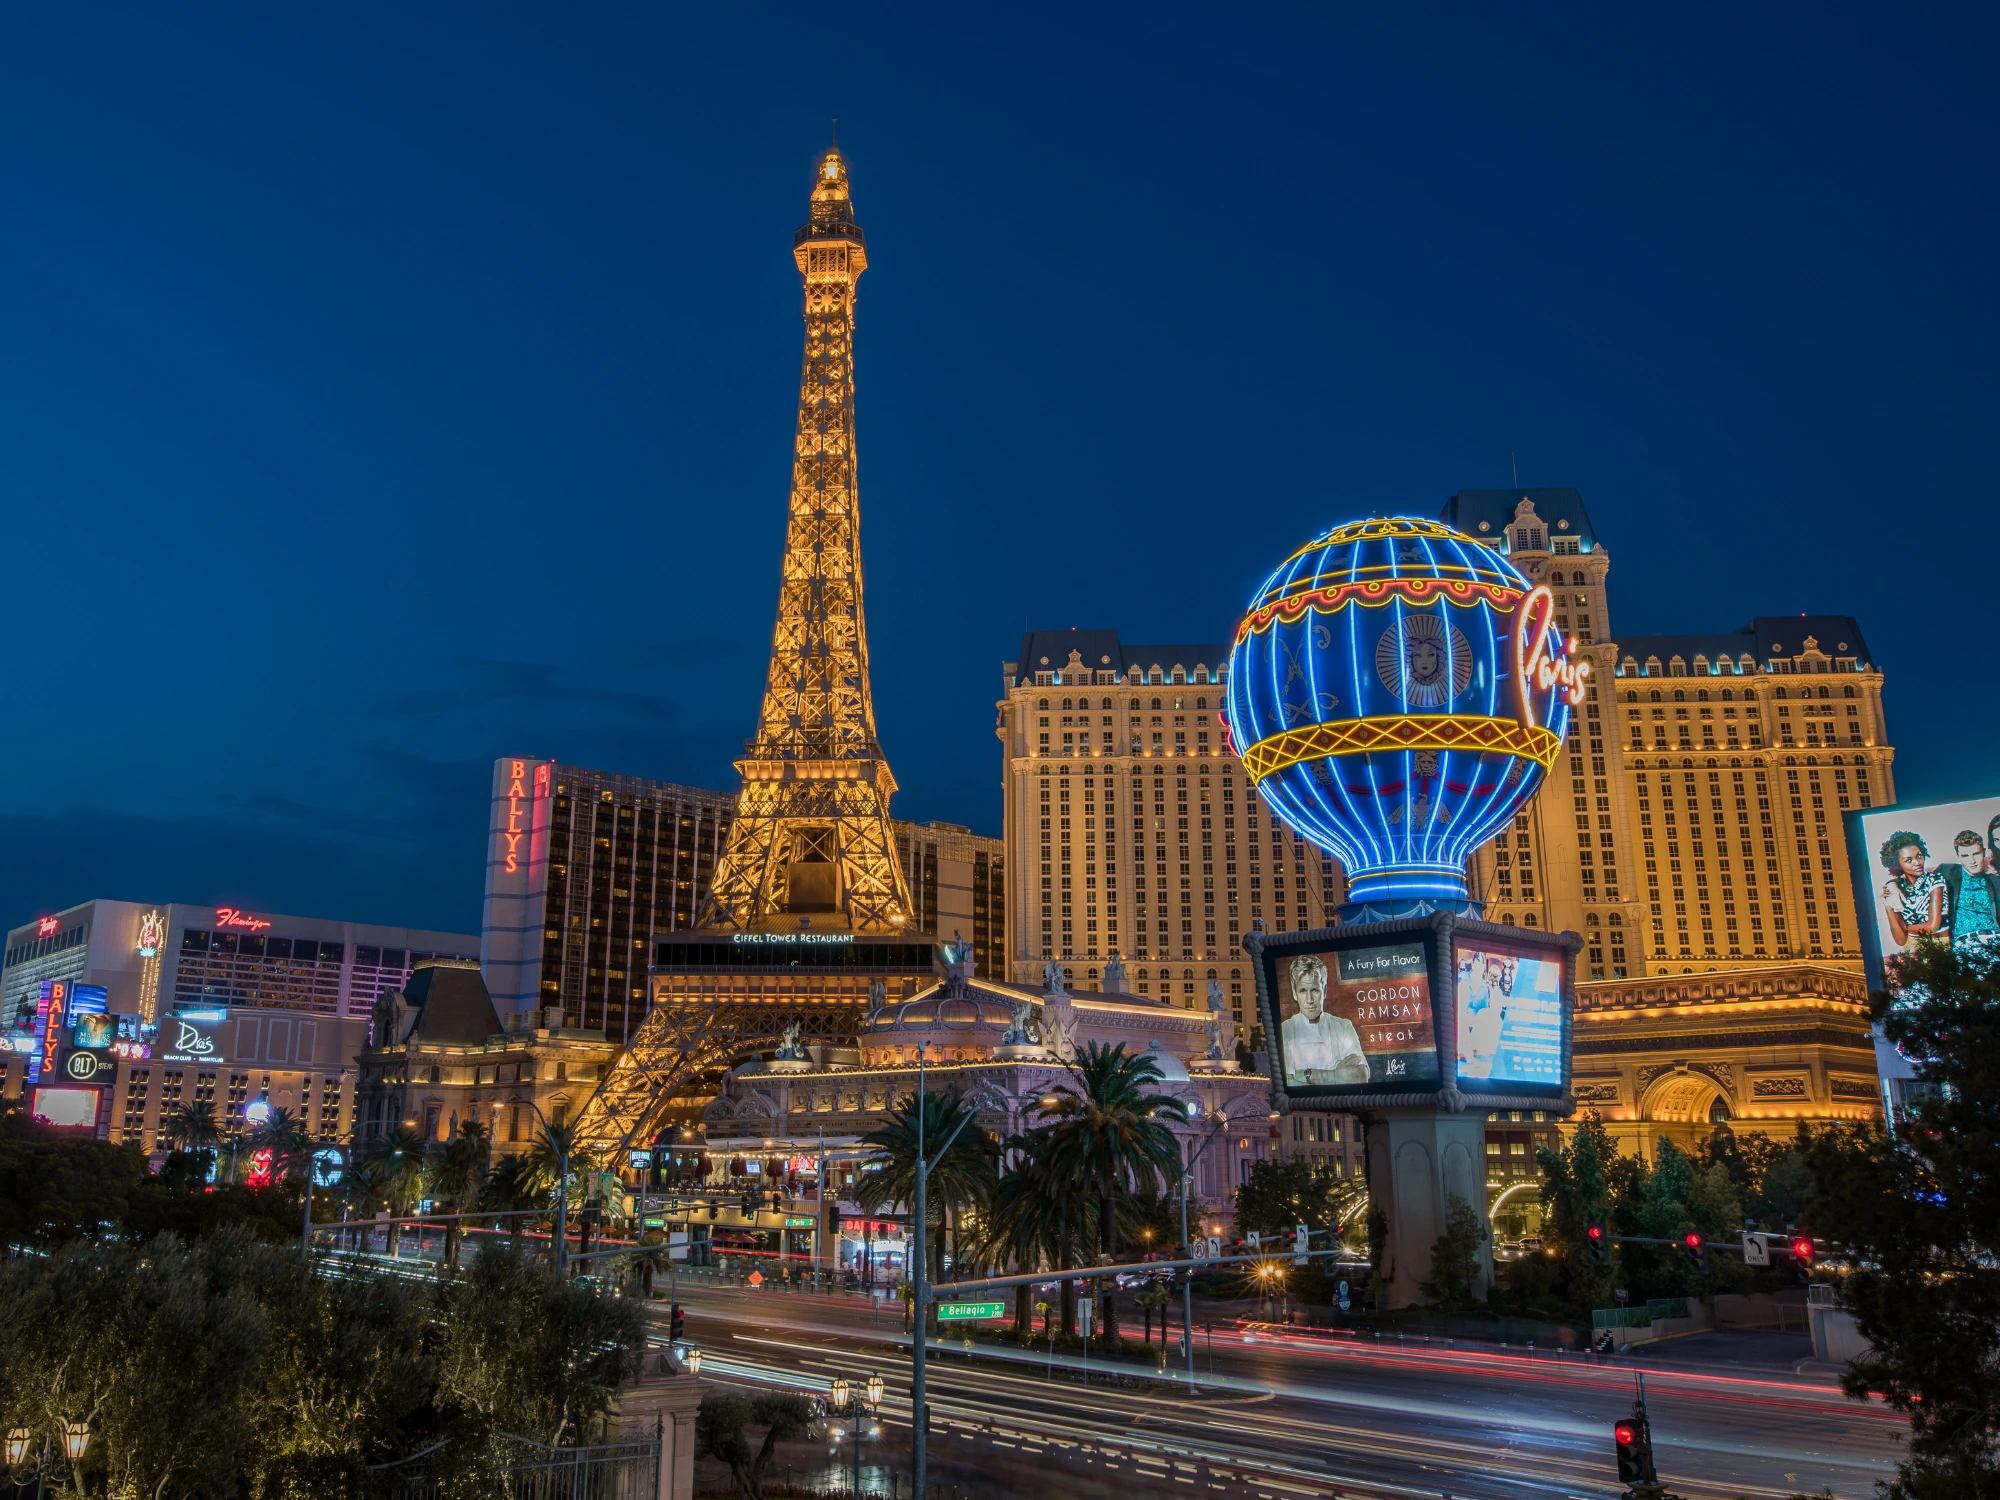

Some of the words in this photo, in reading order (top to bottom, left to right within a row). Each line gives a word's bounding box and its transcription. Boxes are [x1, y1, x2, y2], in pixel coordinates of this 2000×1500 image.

[1517, 585, 1589, 728] Paris
[216, 908, 271, 931] Flamingo
[734, 934, 763, 943] EIFFEL
[765, 934, 796, 943] TOWER
[800, 934, 854, 943] RESTAURANT
[1348, 960, 1355, 971] A
[1356, 959, 1374, 970] Fury
[1376, 957, 1390, 968] For
[1392, 955, 1421, 966] Flavor
[1356, 986, 1420, 1003] GORDON
[1358, 1003, 1420, 1020] RAMSAY
[1370, 1029, 1414, 1042] steak
[74, 1057, 92, 1073] BLT
[949, 1305, 985, 1317] Bellagio
